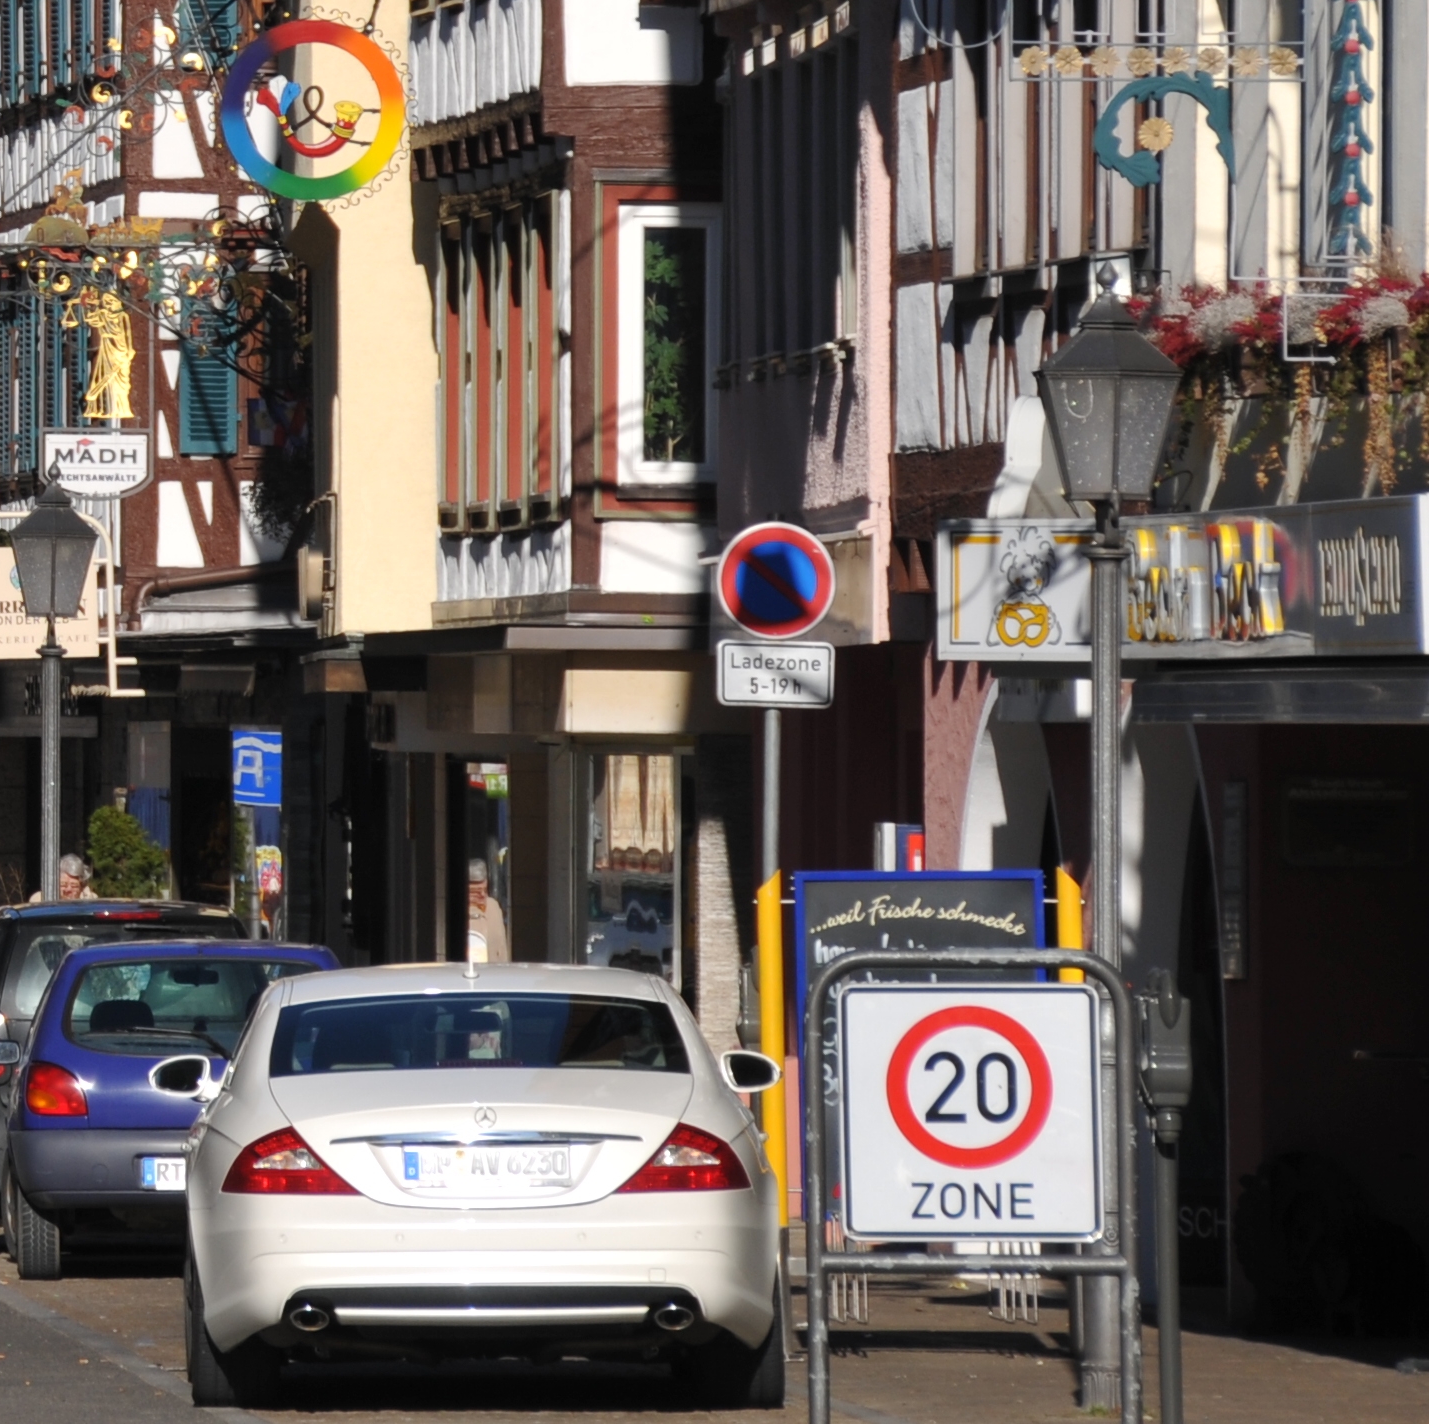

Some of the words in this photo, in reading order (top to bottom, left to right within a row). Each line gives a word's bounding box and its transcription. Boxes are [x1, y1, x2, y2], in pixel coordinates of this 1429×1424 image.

[55, 448, 138, 464] MADH
[58, 473, 138, 482] ECHTSANWÄLTE
[16, 615, 40, 625] DER
[730, 652, 822, 672] Ladezone
[750, 677, 789, 695] 5-19
[793, 679, 802, 695] h
[868, 894, 936, 927] Frische
[937, 901, 1027, 936] schmeckt
[923, 1050, 1019, 1124] 20
[156, 1163, 184, 1182] RT
[912, 1181, 1035, 1220] ZONE
